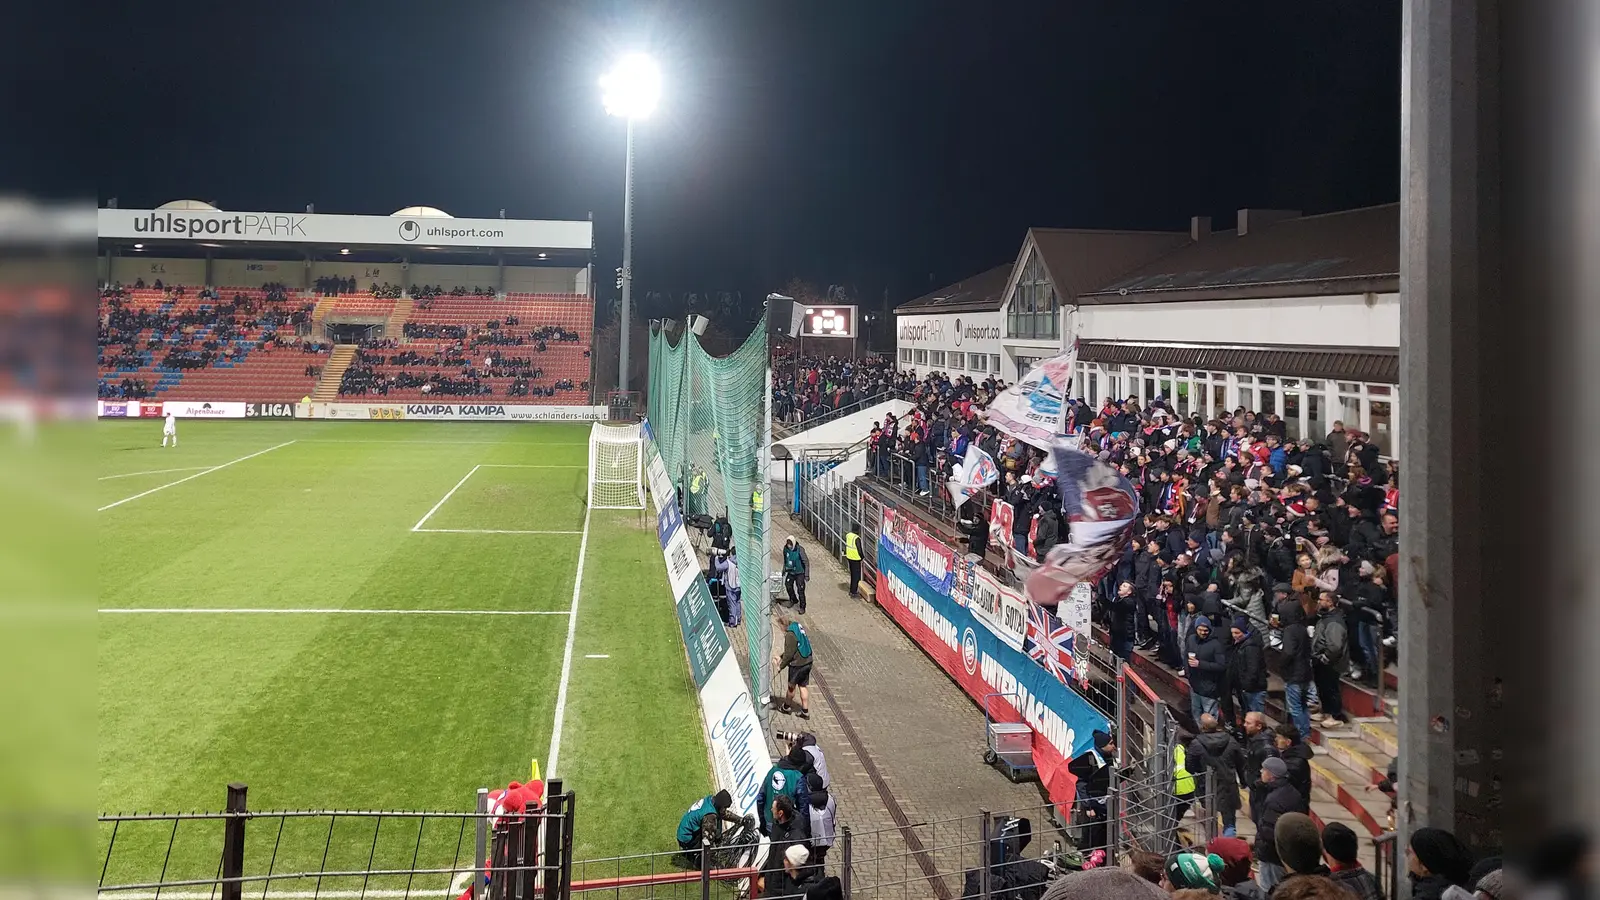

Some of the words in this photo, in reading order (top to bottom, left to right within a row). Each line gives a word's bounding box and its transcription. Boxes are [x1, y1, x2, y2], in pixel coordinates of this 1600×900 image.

[134, 212, 307, 237] uhlsportPARK
[427, 226, 504, 239] uhlsport.com
[899, 319, 946, 345] uhlsportPARK
[246, 403, 259, 416] 3.
[406, 404, 454, 415] KAMPA
[458, 404, 506, 415] KAMPA
[887, 569, 958, 653] SPIELVEREINIGUNG
[980, 650, 1075, 760] UNTERHACHING
